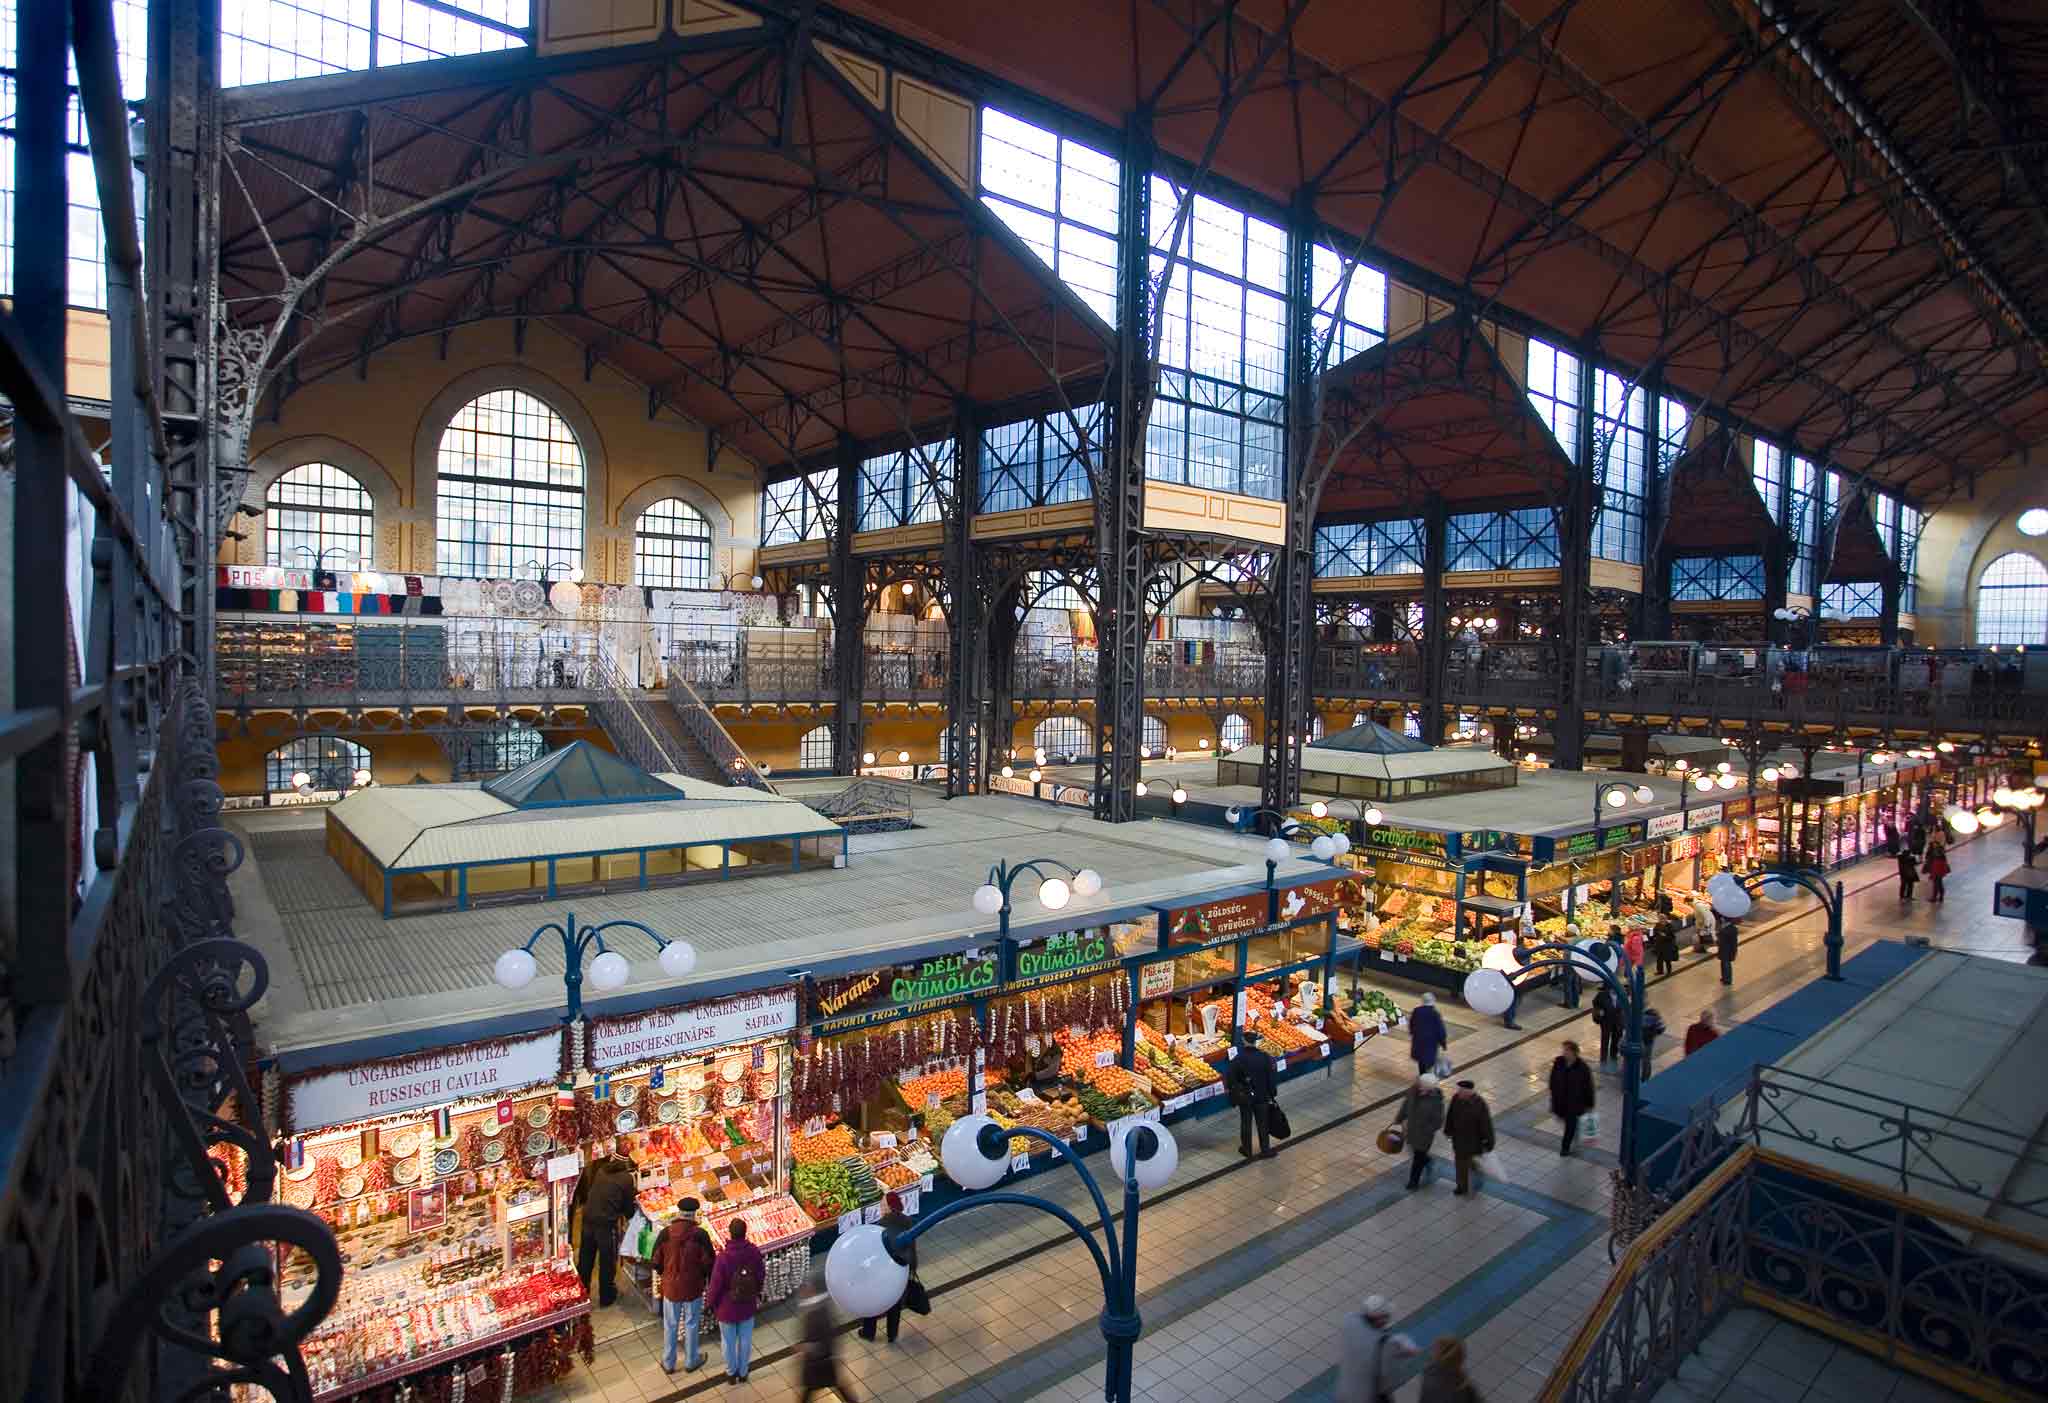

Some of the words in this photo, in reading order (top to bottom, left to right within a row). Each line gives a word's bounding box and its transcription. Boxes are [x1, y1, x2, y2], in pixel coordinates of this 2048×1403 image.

[922, 955, 962, 977] DÉLI
[1019, 937, 1106, 976] GYÜMÖLCS
[818, 971, 881, 1019] Narancs
[891, 960, 994, 1002] GYÜMÖLCS
[593, 1018, 642, 1040] TOKAJER
[649, 1013, 675, 1030] WEIN
[696, 997, 763, 1021] UNGARISCHER
[593, 1025, 716, 1060] UNGARISCHE-SCHNÄPSE
[745, 1011, 784, 1031] SAFRAN
[349, 1056, 442, 1088] UNGARISCHE
[369, 1079, 442, 1106] RUSSISCH
[446, 1067, 498, 1091] CAVIAR
